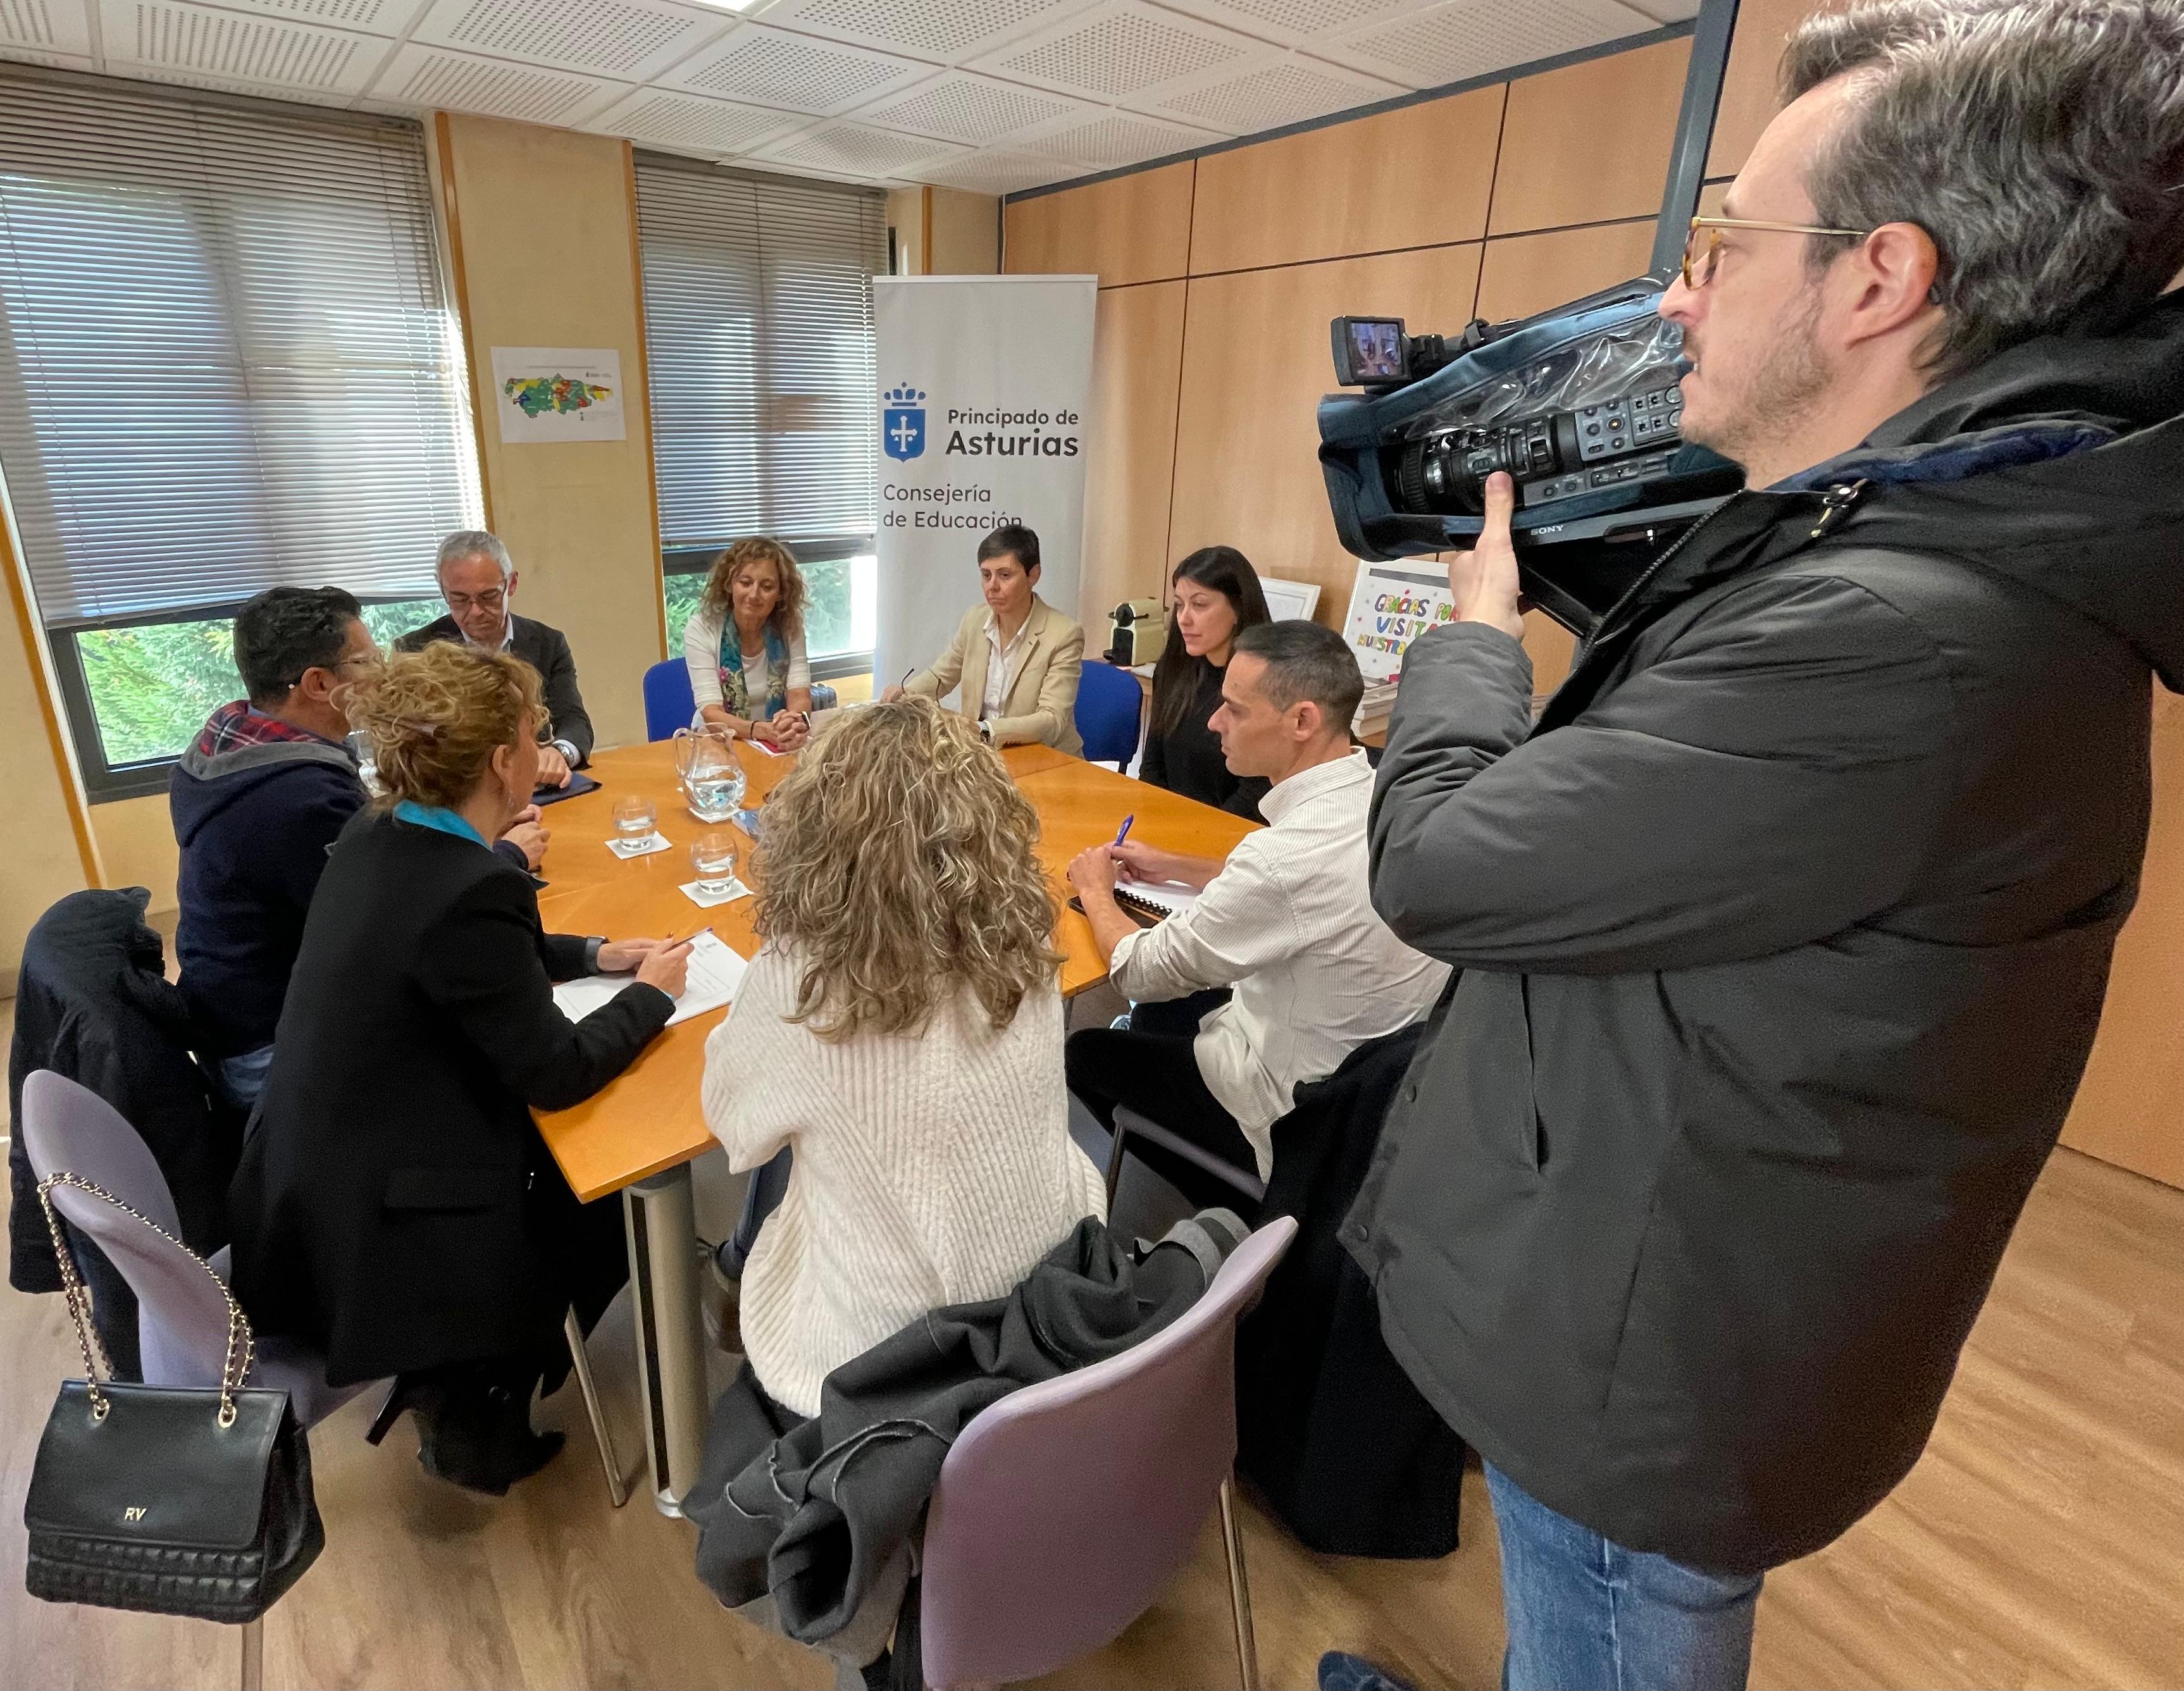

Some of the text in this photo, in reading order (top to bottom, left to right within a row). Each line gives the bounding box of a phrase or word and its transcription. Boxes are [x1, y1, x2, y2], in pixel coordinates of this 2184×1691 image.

[948, 408, 1079, 428] Principado de
[945, 428, 1079, 457] Asturias
[883, 484, 991, 505] Consejería
[883, 510, 907, 527] de
[1530, 524, 1563, 535] SONY
[1374, 593, 1430, 617] GRACIAS
[124, 1507, 147, 1521] RV
